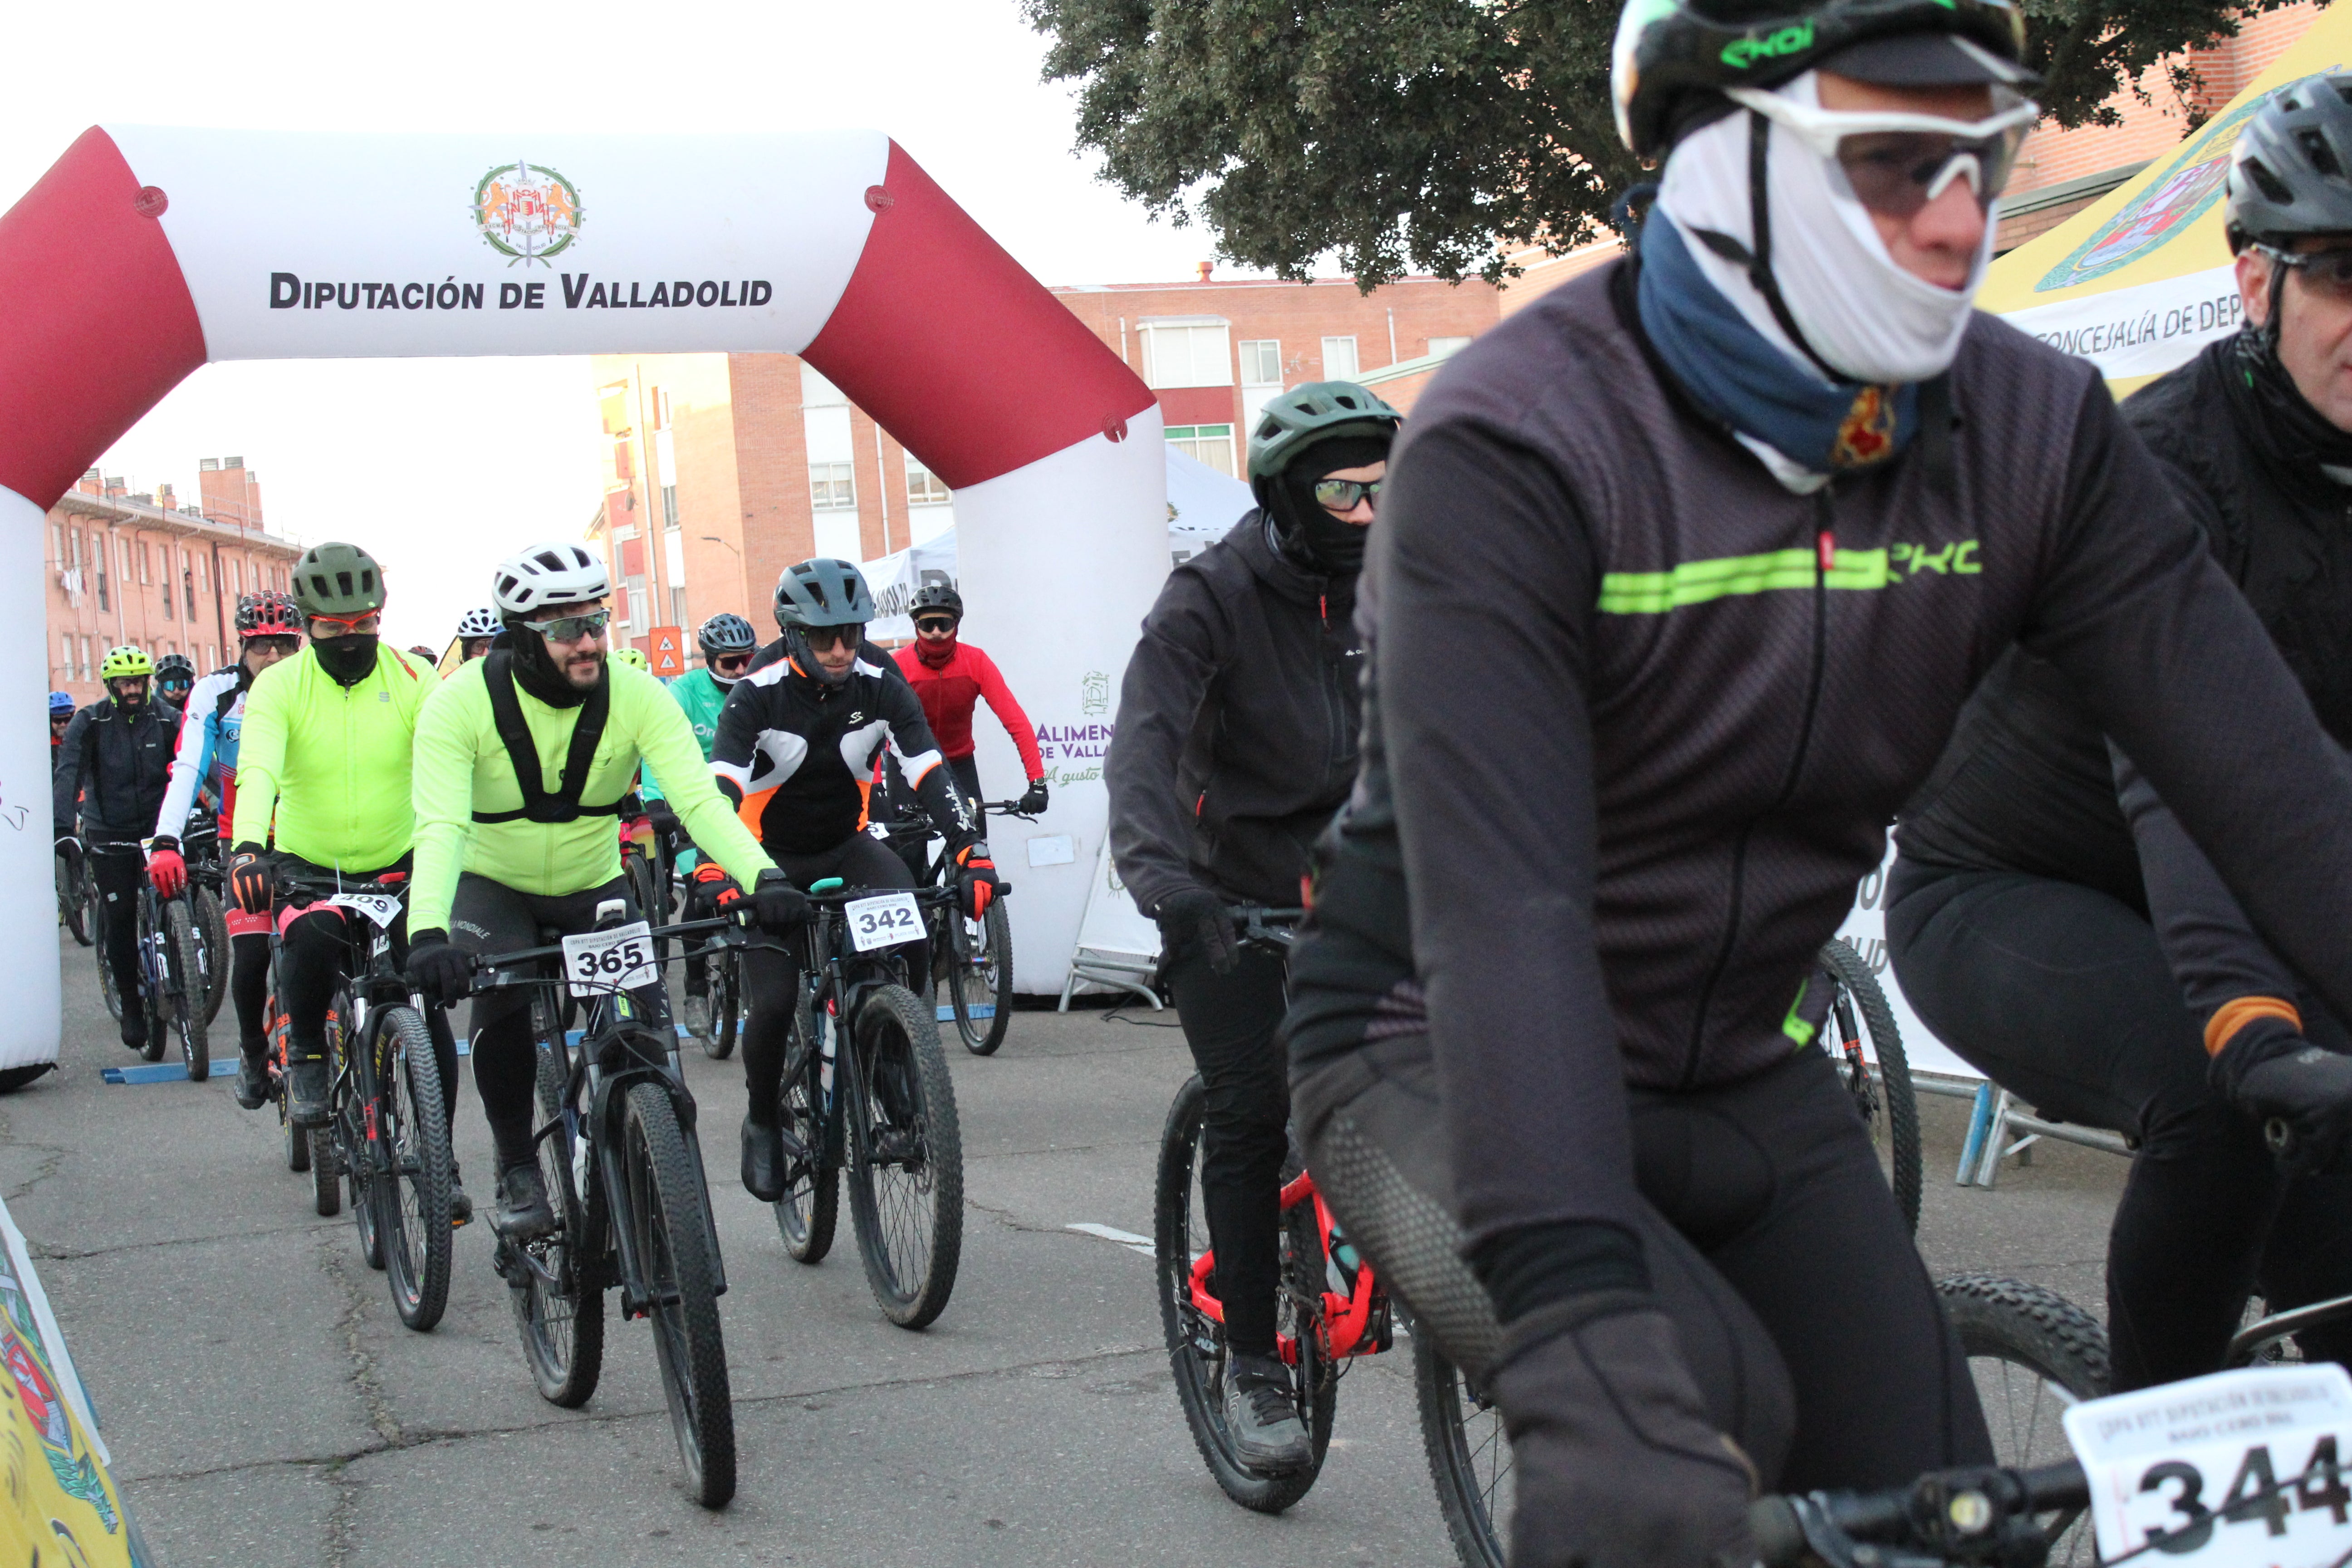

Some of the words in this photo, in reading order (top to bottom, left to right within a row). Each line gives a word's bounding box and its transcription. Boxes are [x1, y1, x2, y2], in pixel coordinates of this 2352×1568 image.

[270, 272, 484, 310] DIPUTACIÓN
[499, 282, 545, 310] DE
[560, 273, 773, 309] VALLADOLID
[2163, 305, 2193, 339] DE
[341, 894, 389, 913] 409
[859, 908, 915, 934] 342
[578, 943, 643, 976] 365
[2139, 1435, 2352, 1554] 344
